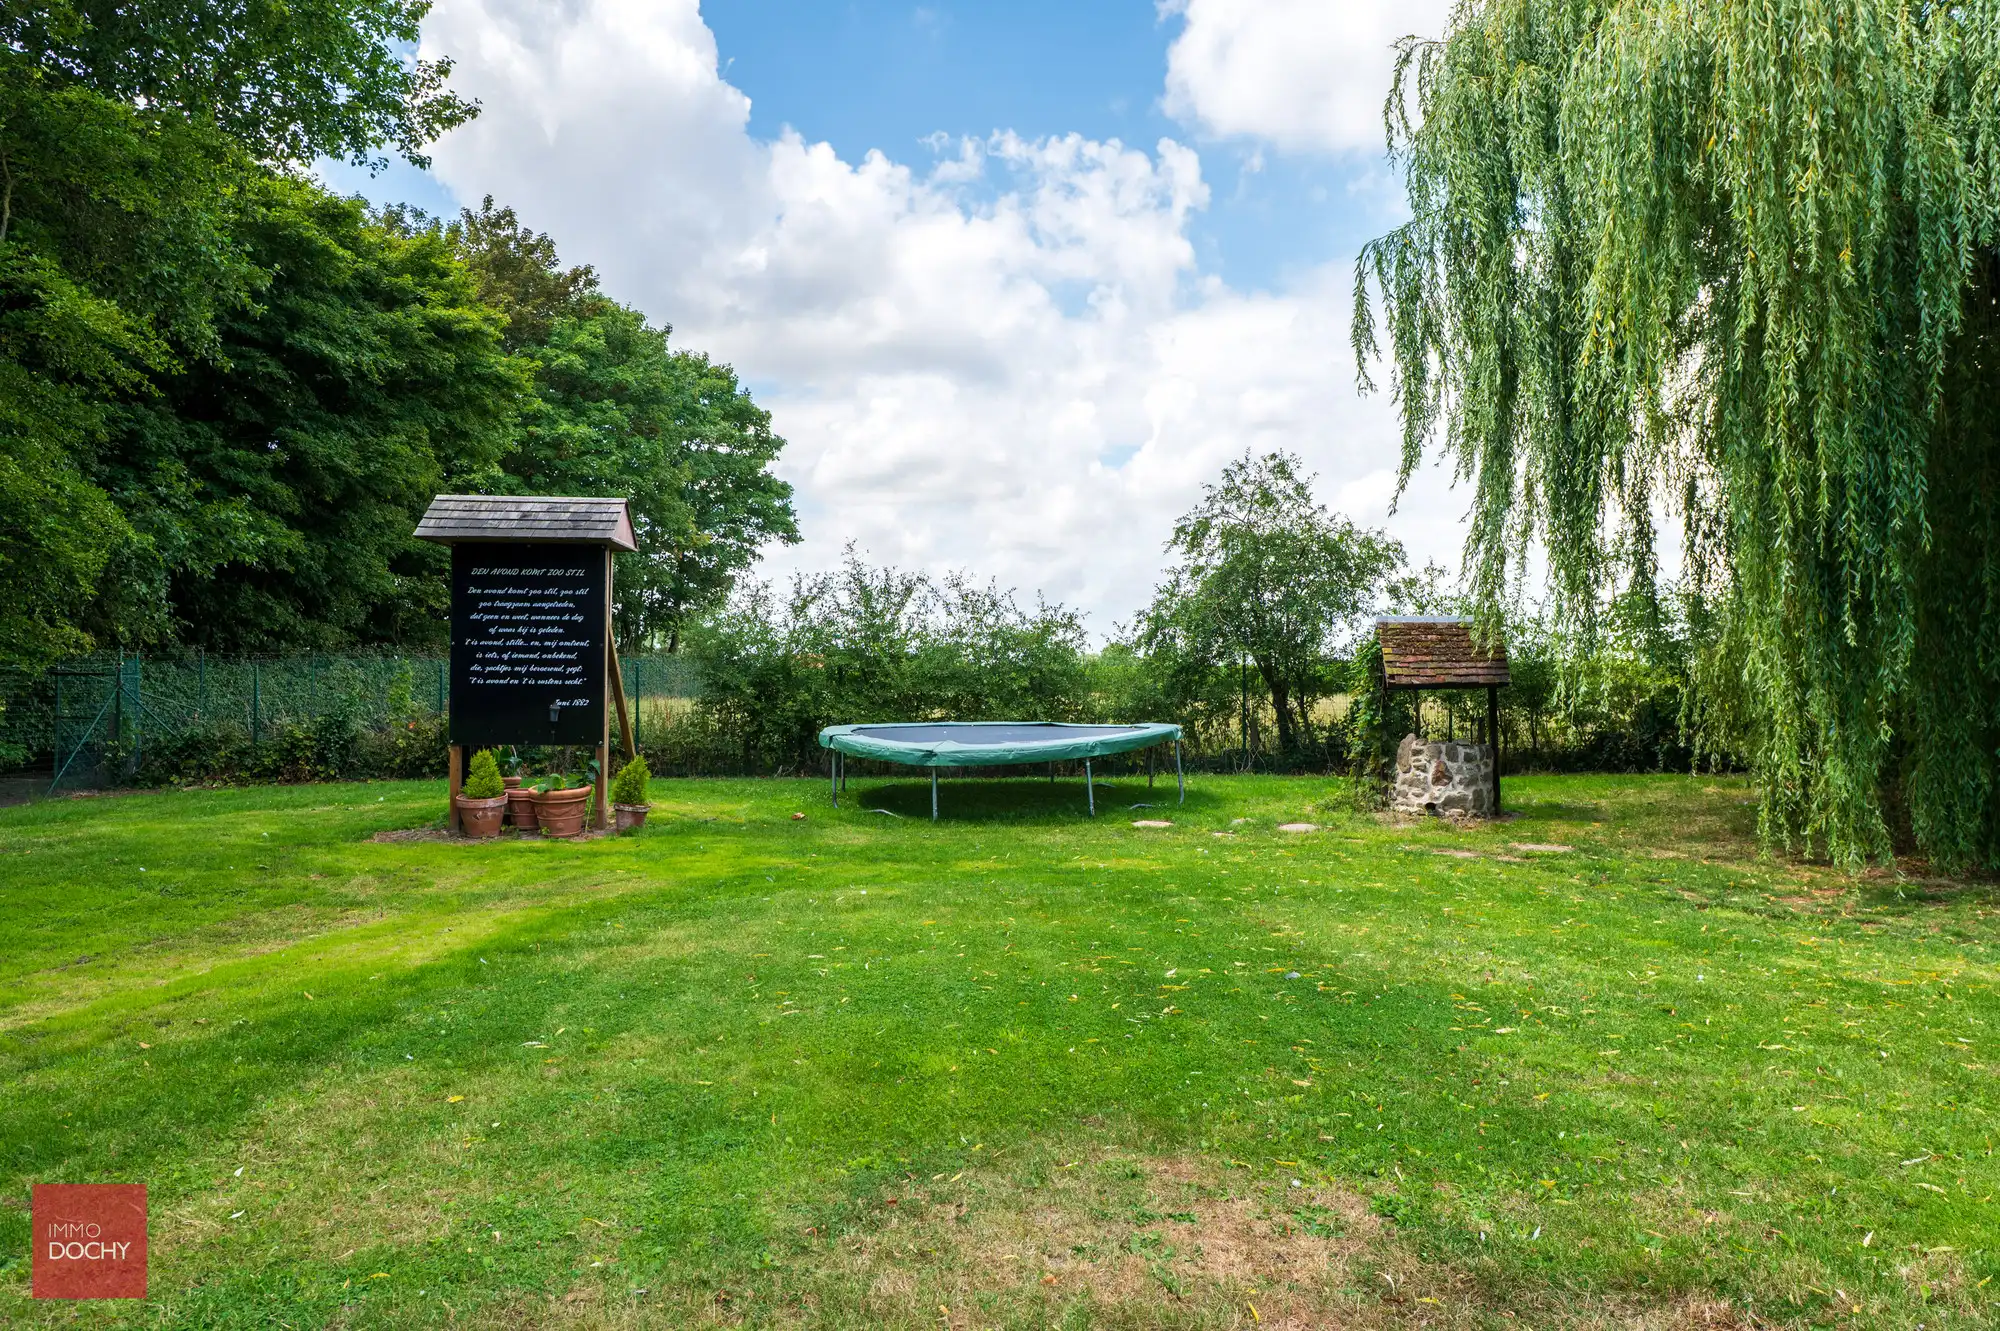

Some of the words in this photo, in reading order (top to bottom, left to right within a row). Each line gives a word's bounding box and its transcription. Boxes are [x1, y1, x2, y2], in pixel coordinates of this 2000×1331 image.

[520, 568, 546, 576] KOMT
[572, 614, 584, 622] dag
[488, 626, 498, 634] of
[480, 638, 504, 646] avond,
[502, 651, 512, 660] of
[514, 665, 528, 673] mij
